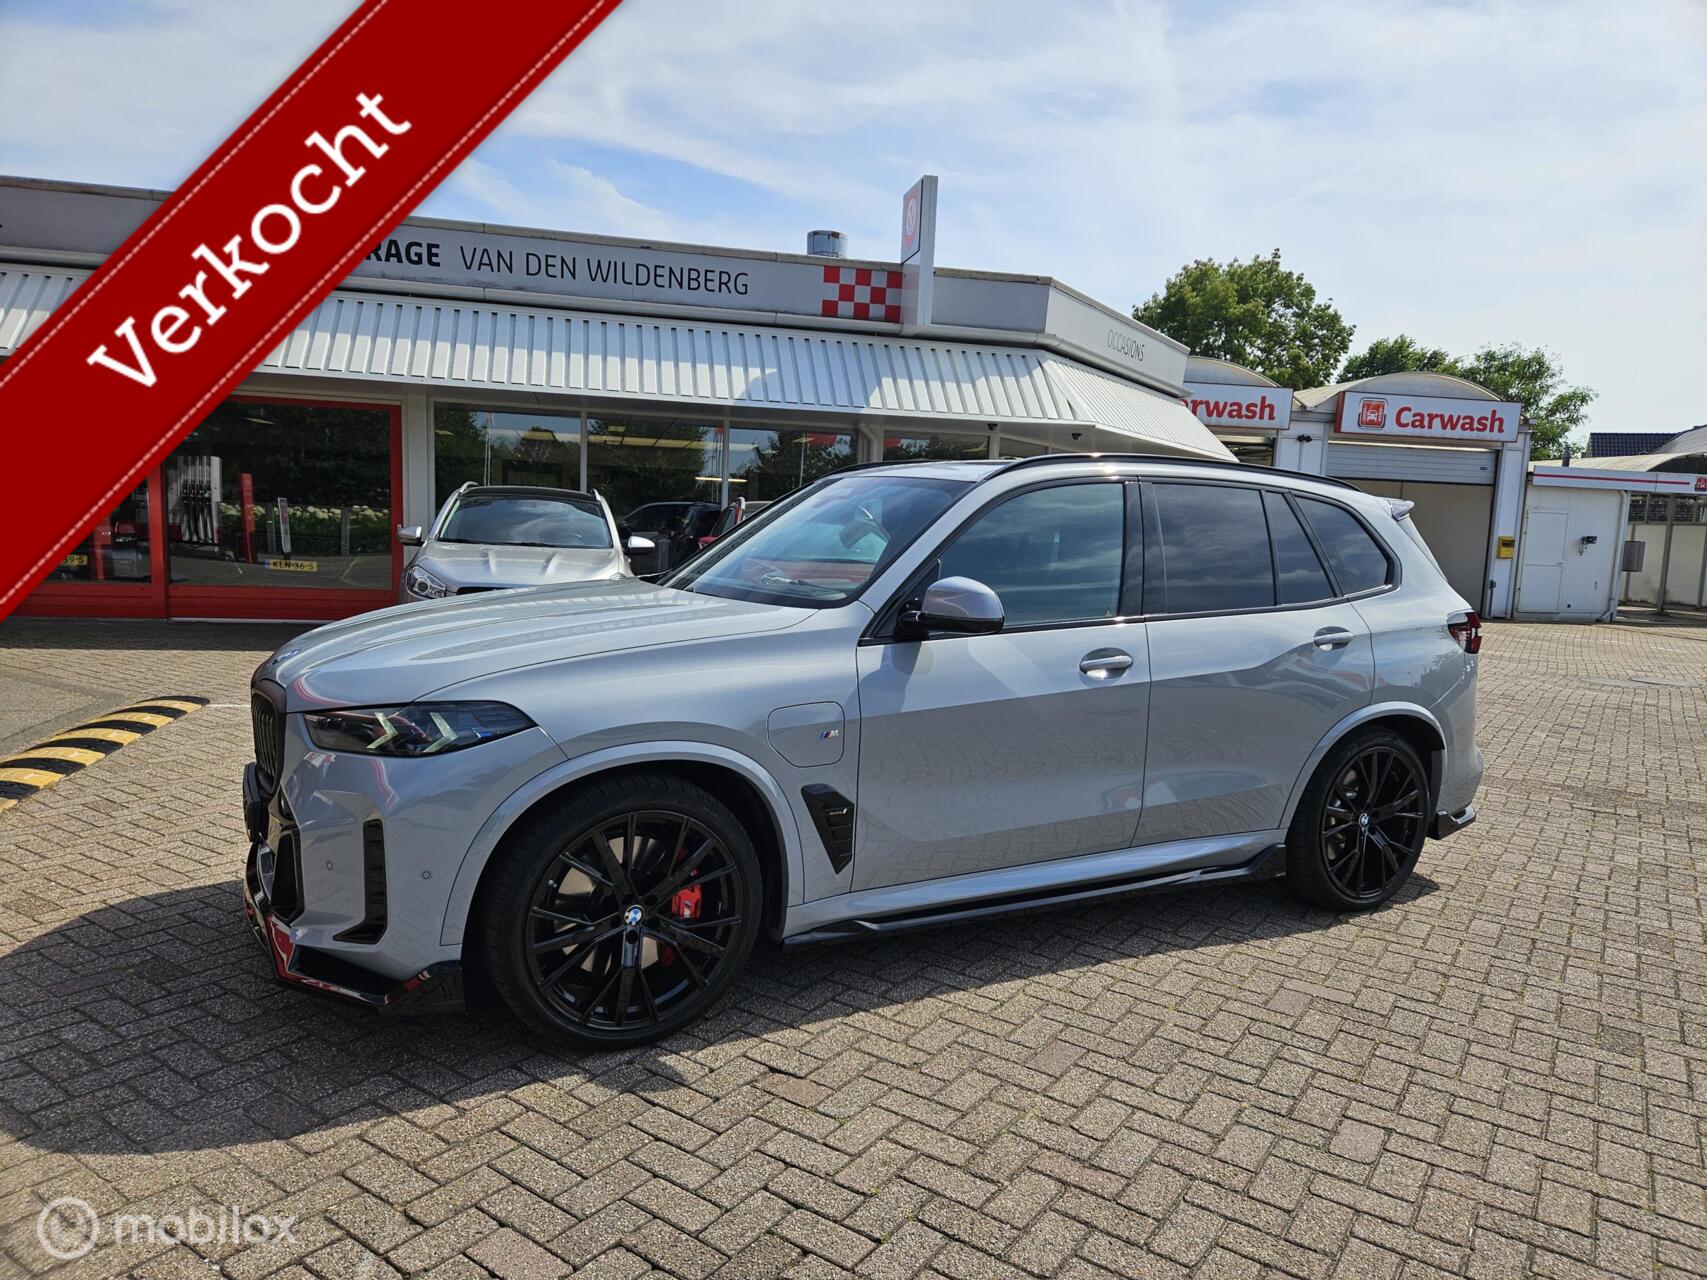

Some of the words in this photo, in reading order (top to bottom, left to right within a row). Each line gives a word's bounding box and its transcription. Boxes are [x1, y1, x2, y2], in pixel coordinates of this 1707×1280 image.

[459, 245, 514, 275] VAN
[525, 252, 577, 280] DEN
[586, 257, 749, 296] WILDENBERG
[1107, 328, 1146, 362] OCCASIONS
[1394, 406, 1505, 434] Carwash
